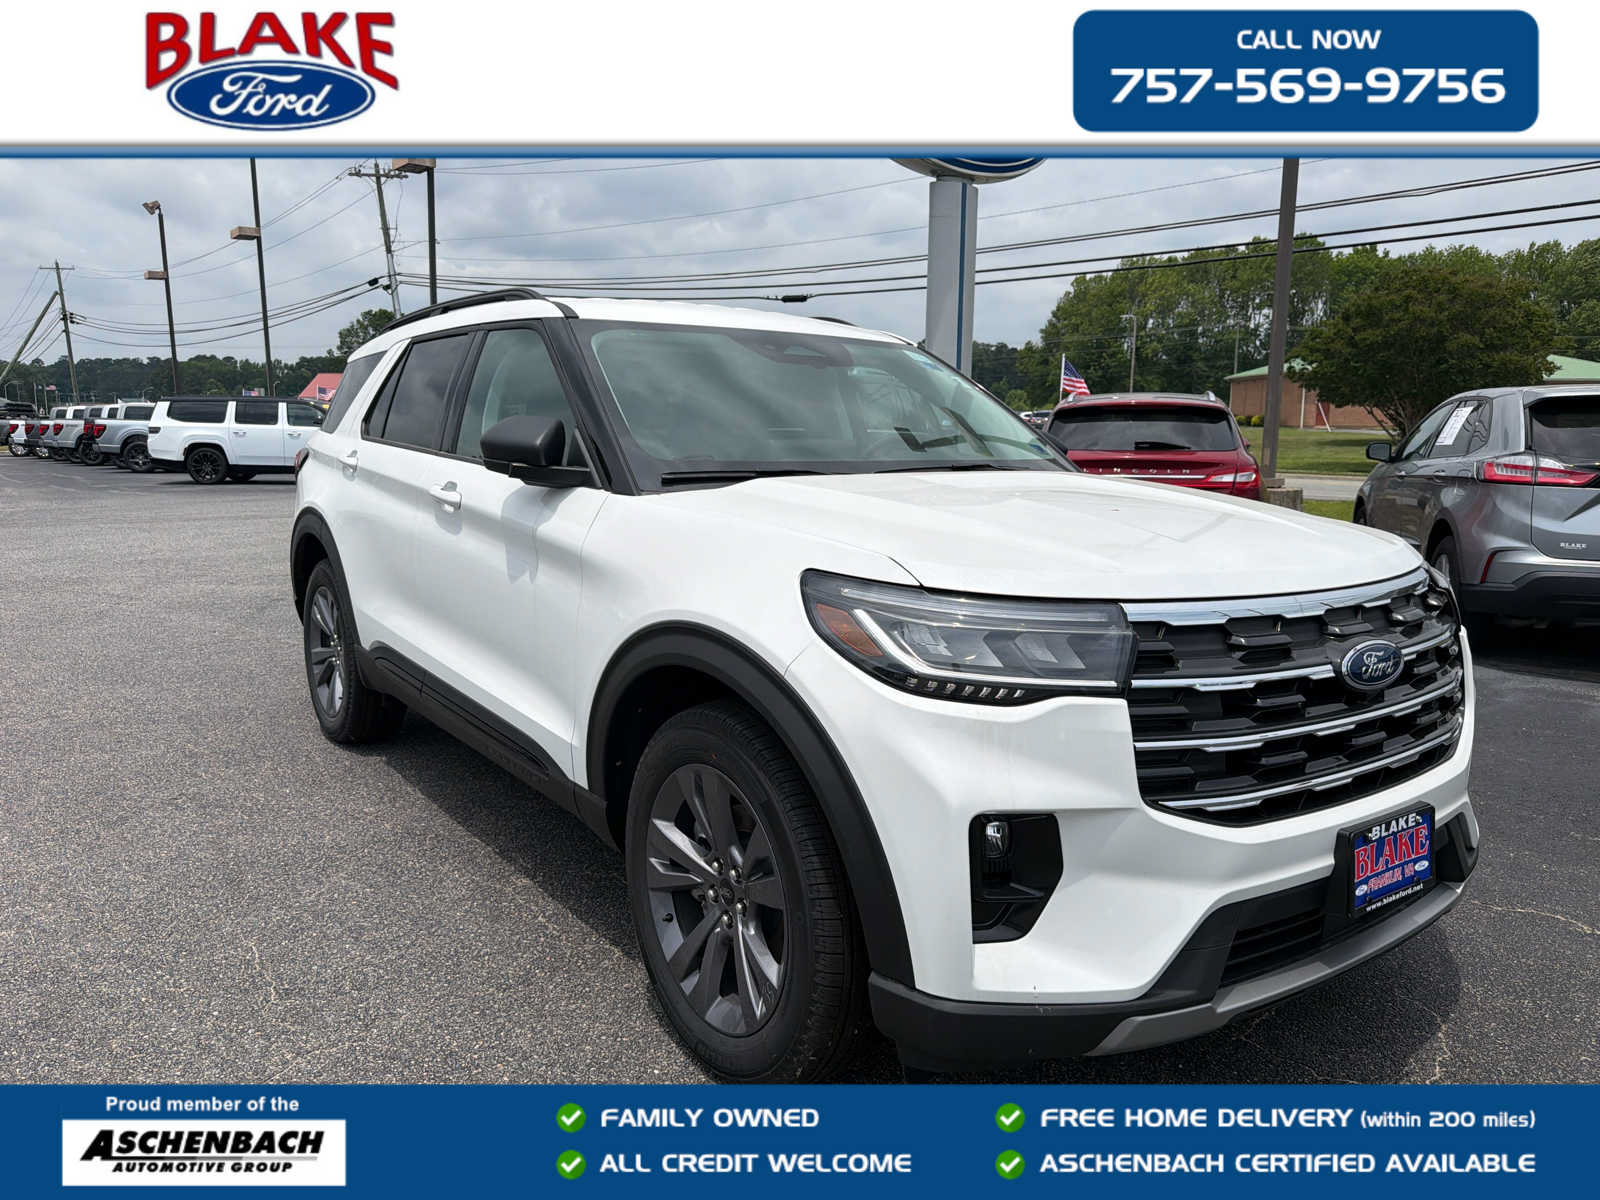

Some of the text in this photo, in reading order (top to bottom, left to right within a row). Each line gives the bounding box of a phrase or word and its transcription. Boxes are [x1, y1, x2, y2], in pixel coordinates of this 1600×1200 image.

[1361, 650, 1395, 680] Ford
[1370, 812, 1417, 841] BLAKE
[1354, 823, 1430, 883] BLAKE
[1365, 882, 1424, 912] www.blakeford.net
